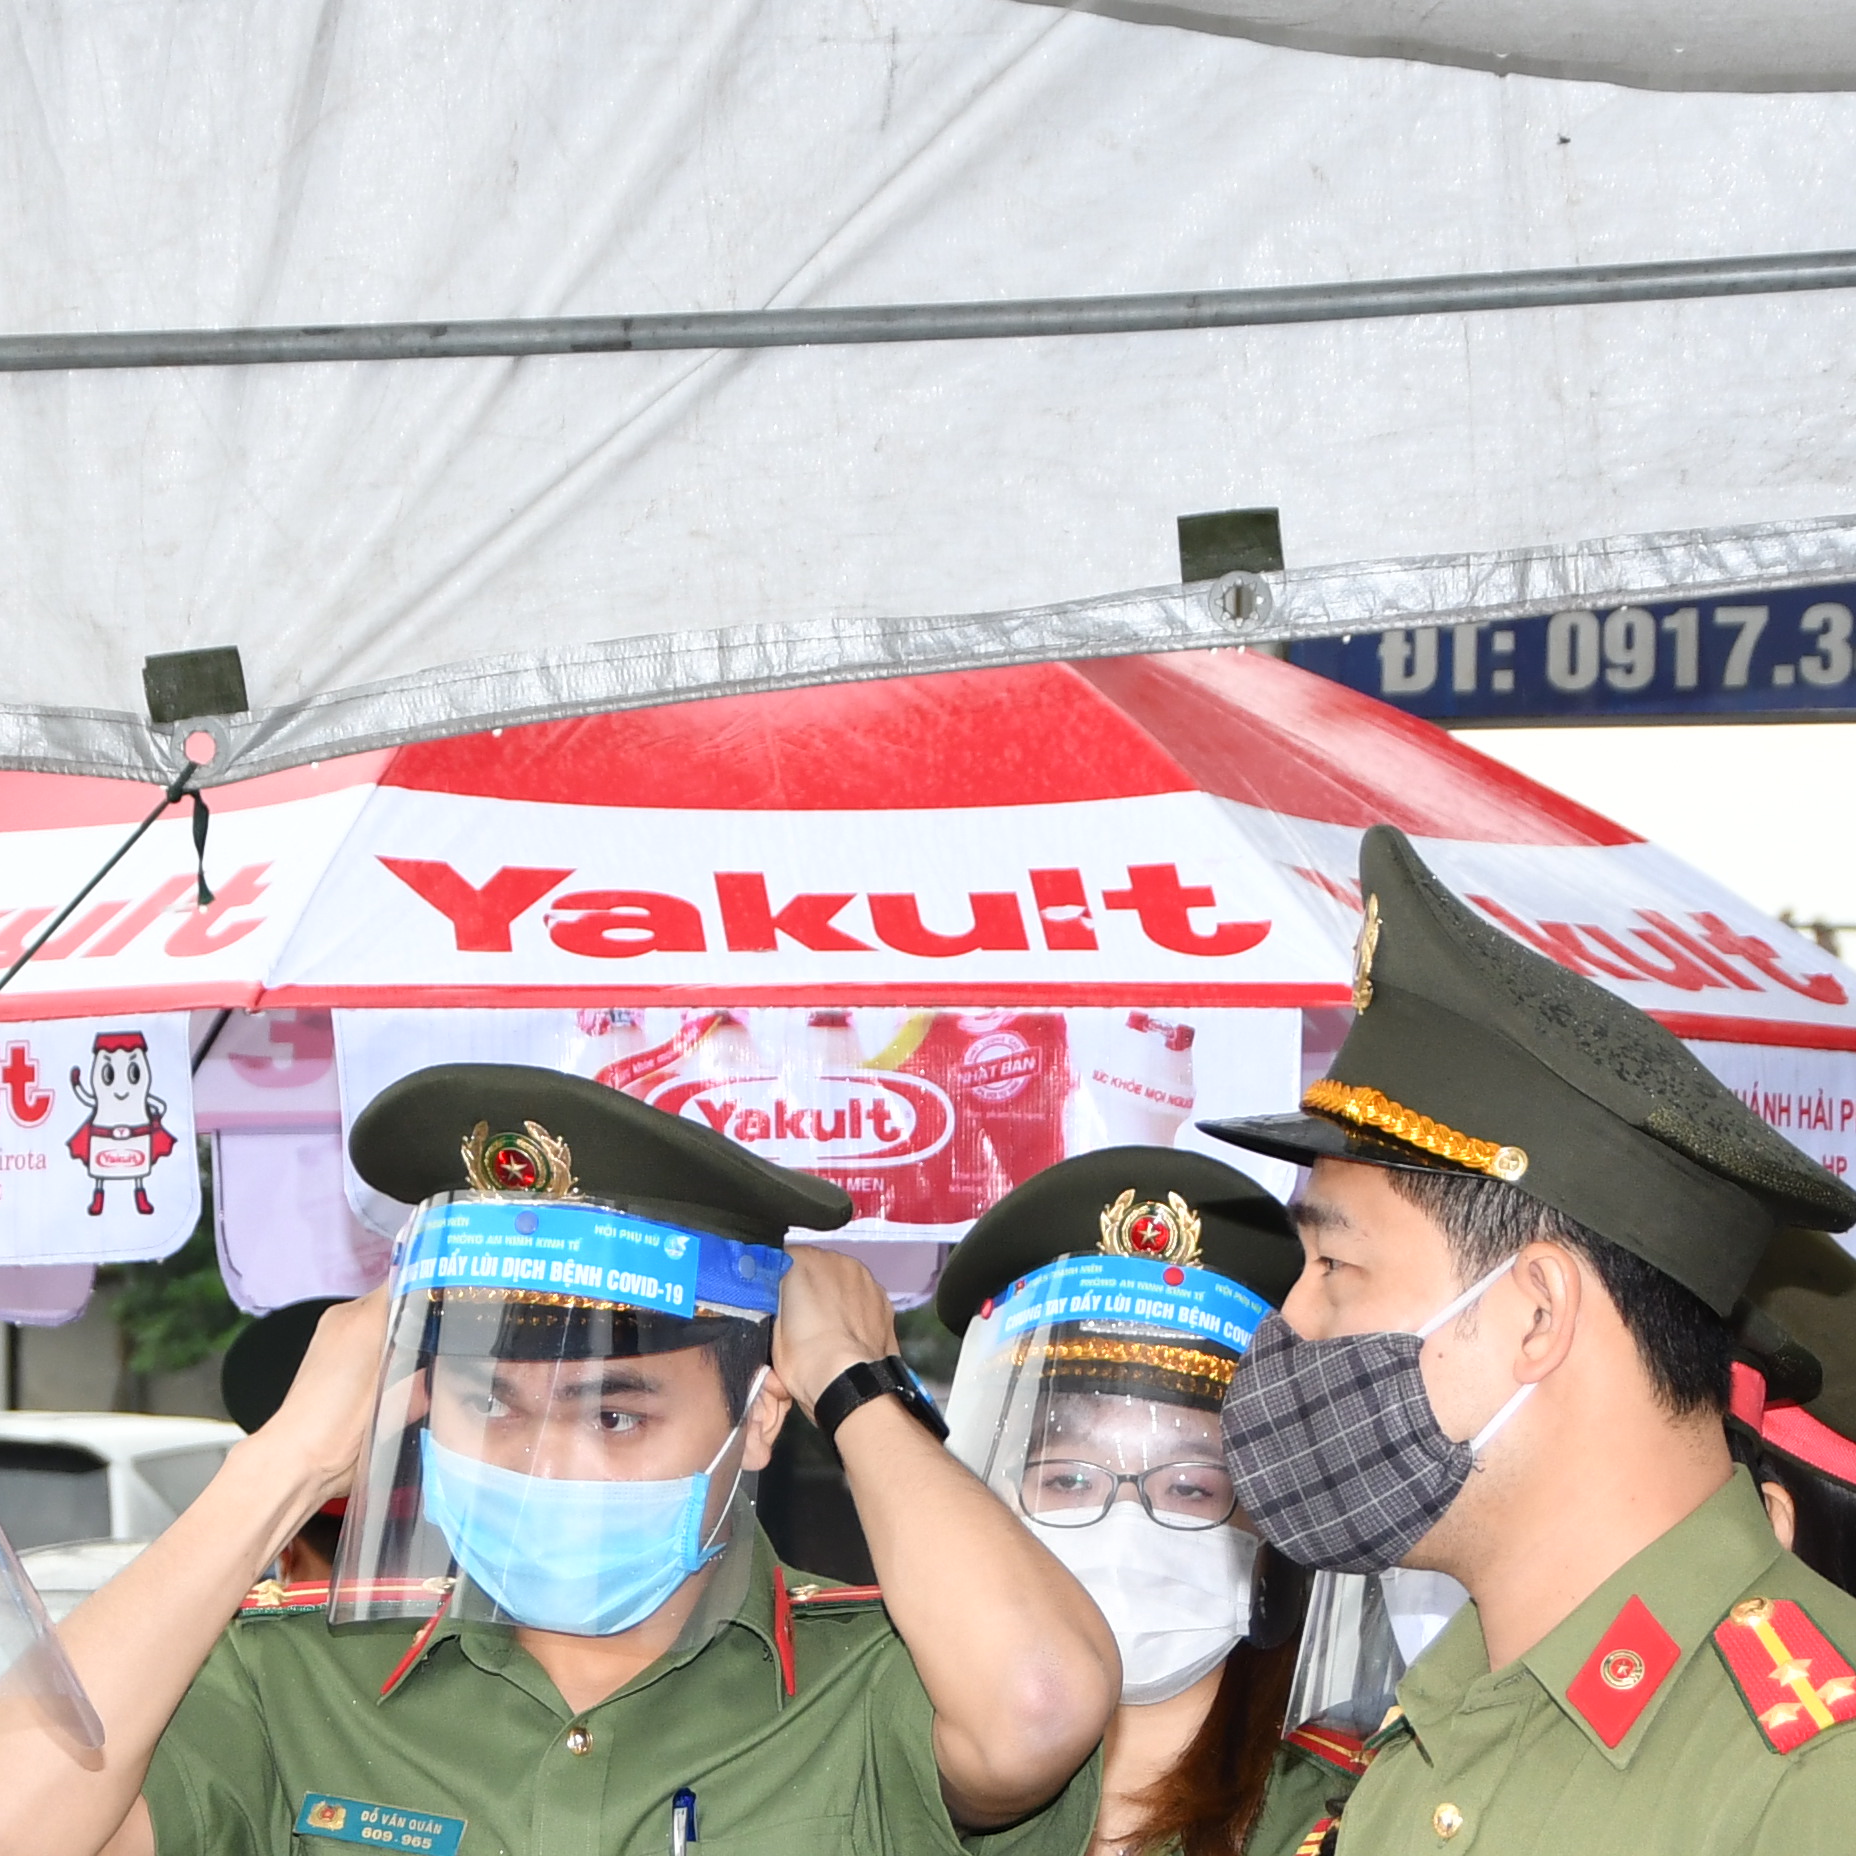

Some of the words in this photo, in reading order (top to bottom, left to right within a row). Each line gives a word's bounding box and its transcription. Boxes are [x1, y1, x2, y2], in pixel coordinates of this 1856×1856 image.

[375, 855, 1272, 959] Yakult
[695, 1097, 906, 1142] Yakult
[1732, 1081, 1792, 1127] ÁNH
[1798, 1088, 1833, 1132] HẢI
[847, 1177, 884, 1191] MEN
[502, 1257, 546, 1283] DỊCH
[550, 1259, 602, 1289] BỆNH
[607, 1269, 684, 1306] COVID-19
[1045, 1298, 1068, 1317] TAY
[1135, 1298, 1174, 1320] DỊCH
[1178, 1306, 1221, 1329] BỆNH
[361, 1827, 393, 1842] 609
[401, 1834, 432, 1849] 965
